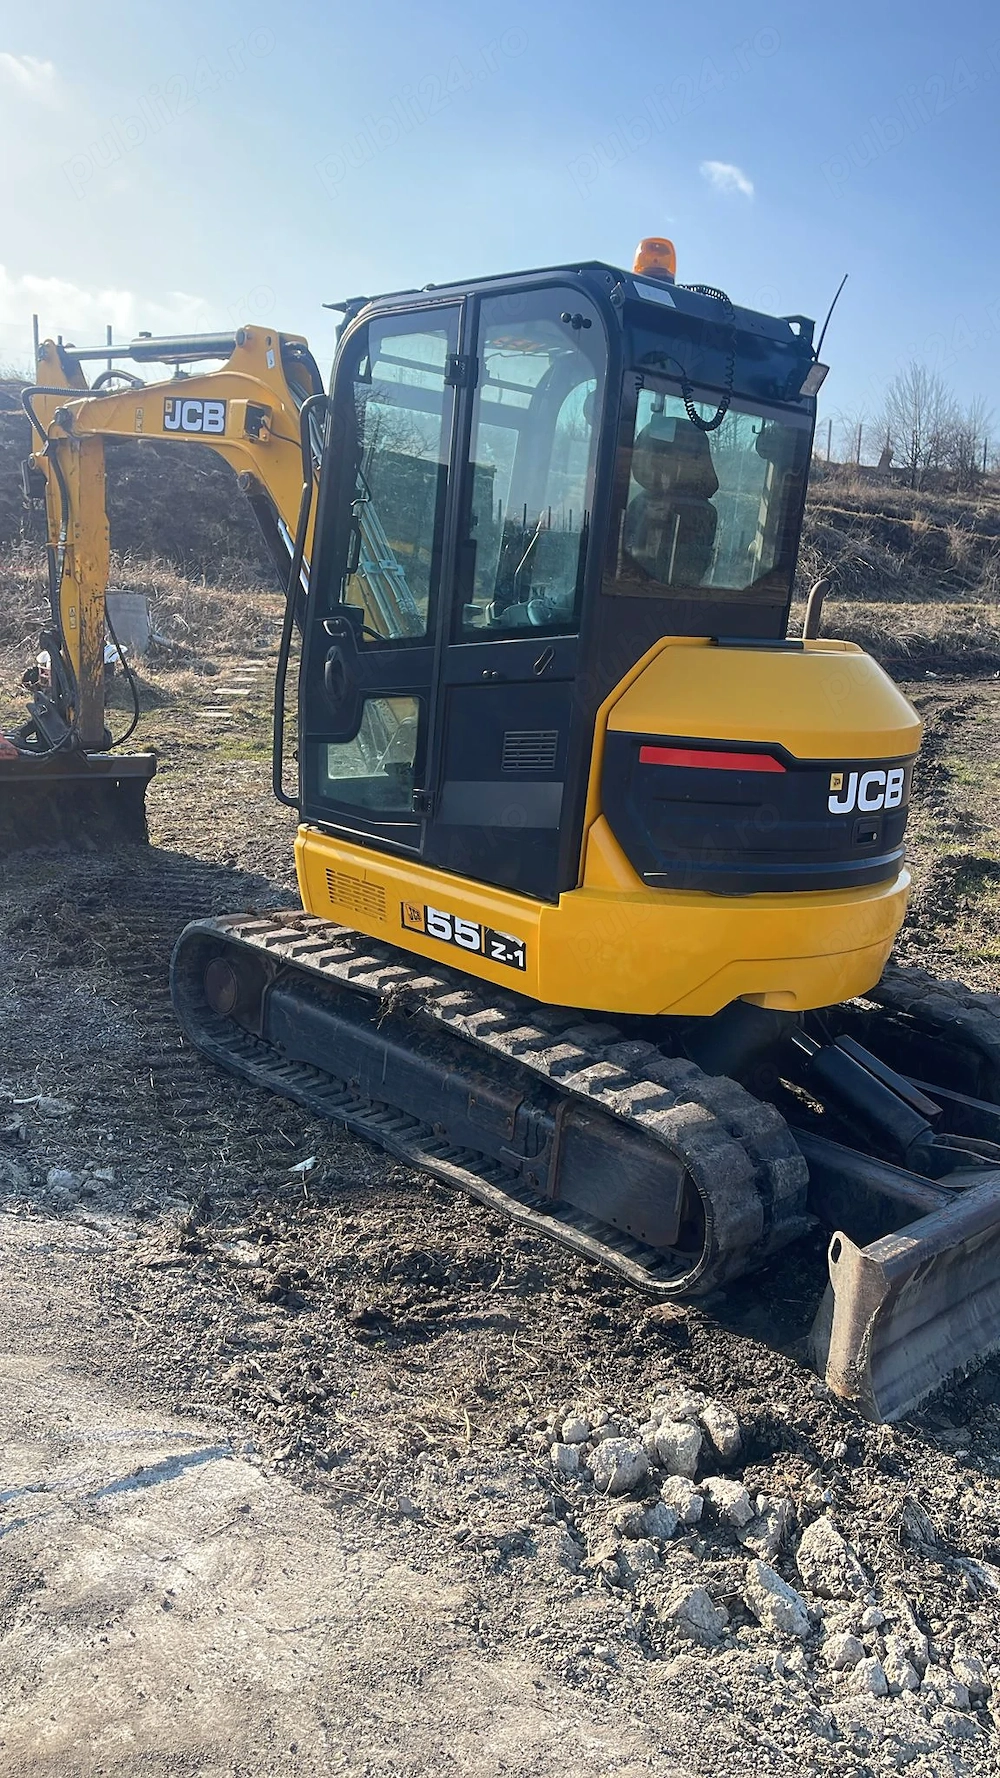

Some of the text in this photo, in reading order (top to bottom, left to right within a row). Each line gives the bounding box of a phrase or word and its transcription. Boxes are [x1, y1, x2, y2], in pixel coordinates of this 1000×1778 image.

[164, 400, 225, 433] JCB
[828, 767, 905, 814] JCB
[427, 905, 481, 950] 55
